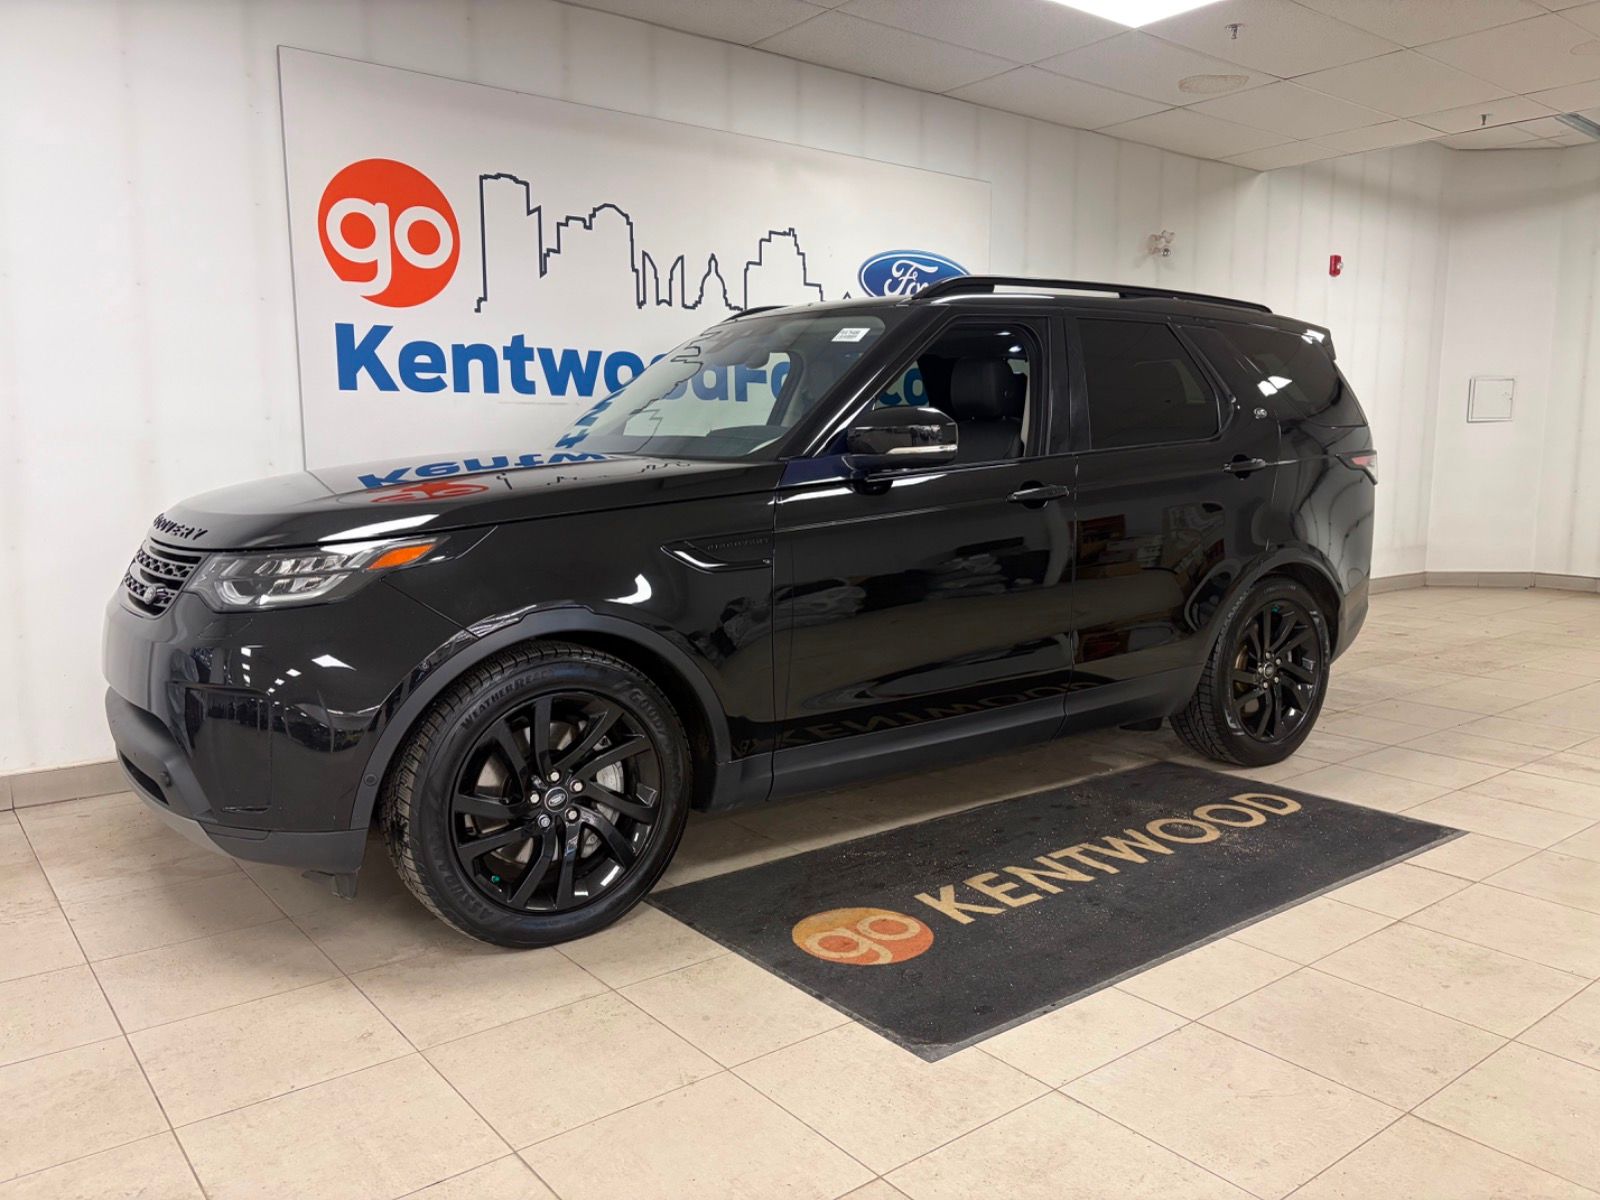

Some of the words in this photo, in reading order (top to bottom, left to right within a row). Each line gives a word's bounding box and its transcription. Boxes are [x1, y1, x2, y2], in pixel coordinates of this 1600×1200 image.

[326, 197, 453, 297] go
[884, 259, 938, 297] Fo
[805, 912, 921, 966] go
[914, 792, 1302, 925] KENTWOOD
